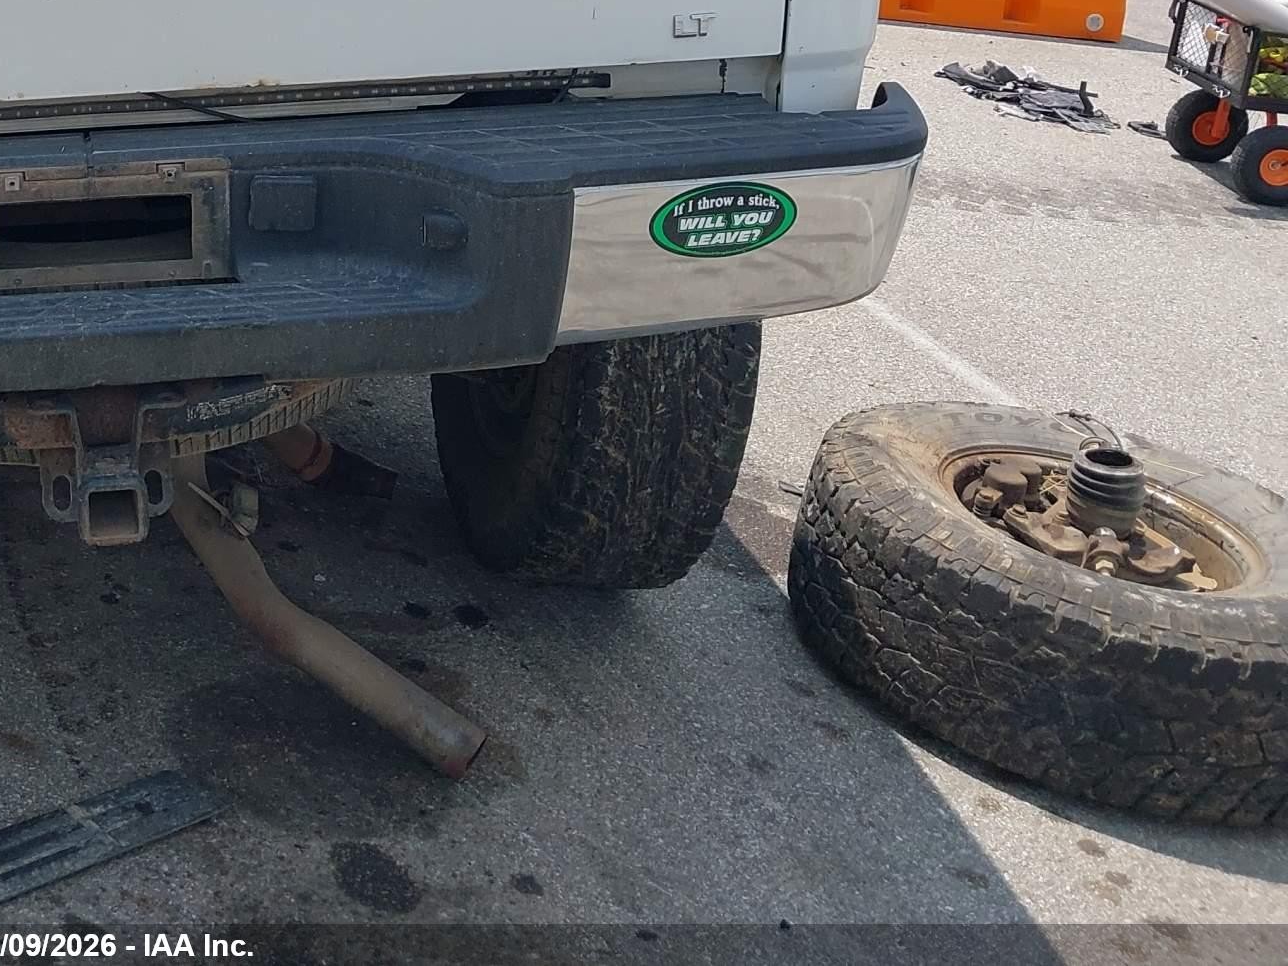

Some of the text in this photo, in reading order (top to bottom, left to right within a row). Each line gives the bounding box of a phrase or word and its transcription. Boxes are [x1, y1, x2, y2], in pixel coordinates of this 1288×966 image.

[673, 12, 717, 38] LT
[673, 193, 780, 217] If I throw a stick,
[679, 211, 773, 231] WILL YOU
[687, 229, 761, 247] LEAVE?
